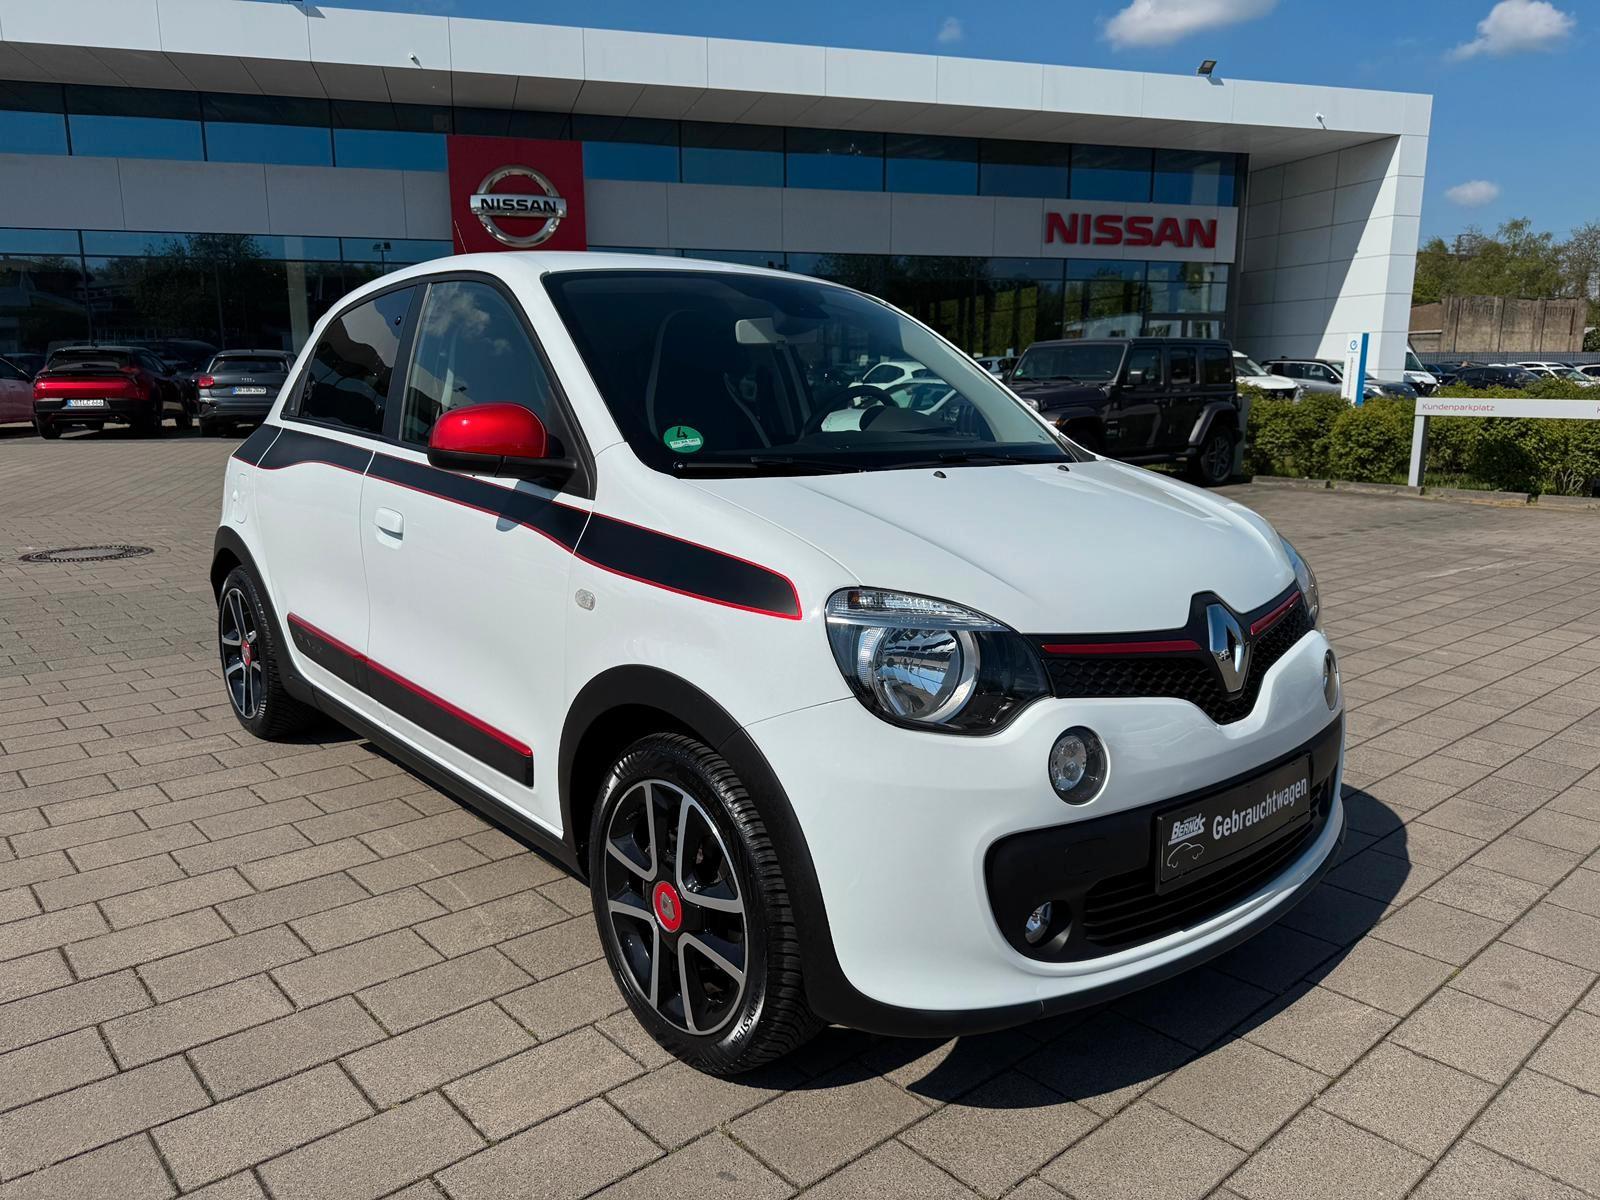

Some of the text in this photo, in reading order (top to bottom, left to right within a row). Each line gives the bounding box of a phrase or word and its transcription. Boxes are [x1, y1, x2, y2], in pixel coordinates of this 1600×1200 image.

[480, 198, 557, 213] NISSAN
[1045, 212, 1217, 248] NISSAN
[1422, 403, 1495, 411] Kundenparkplatz
[677, 426, 688, 439] 4
[1212, 777, 1307, 840] Gebrauchtwagen
